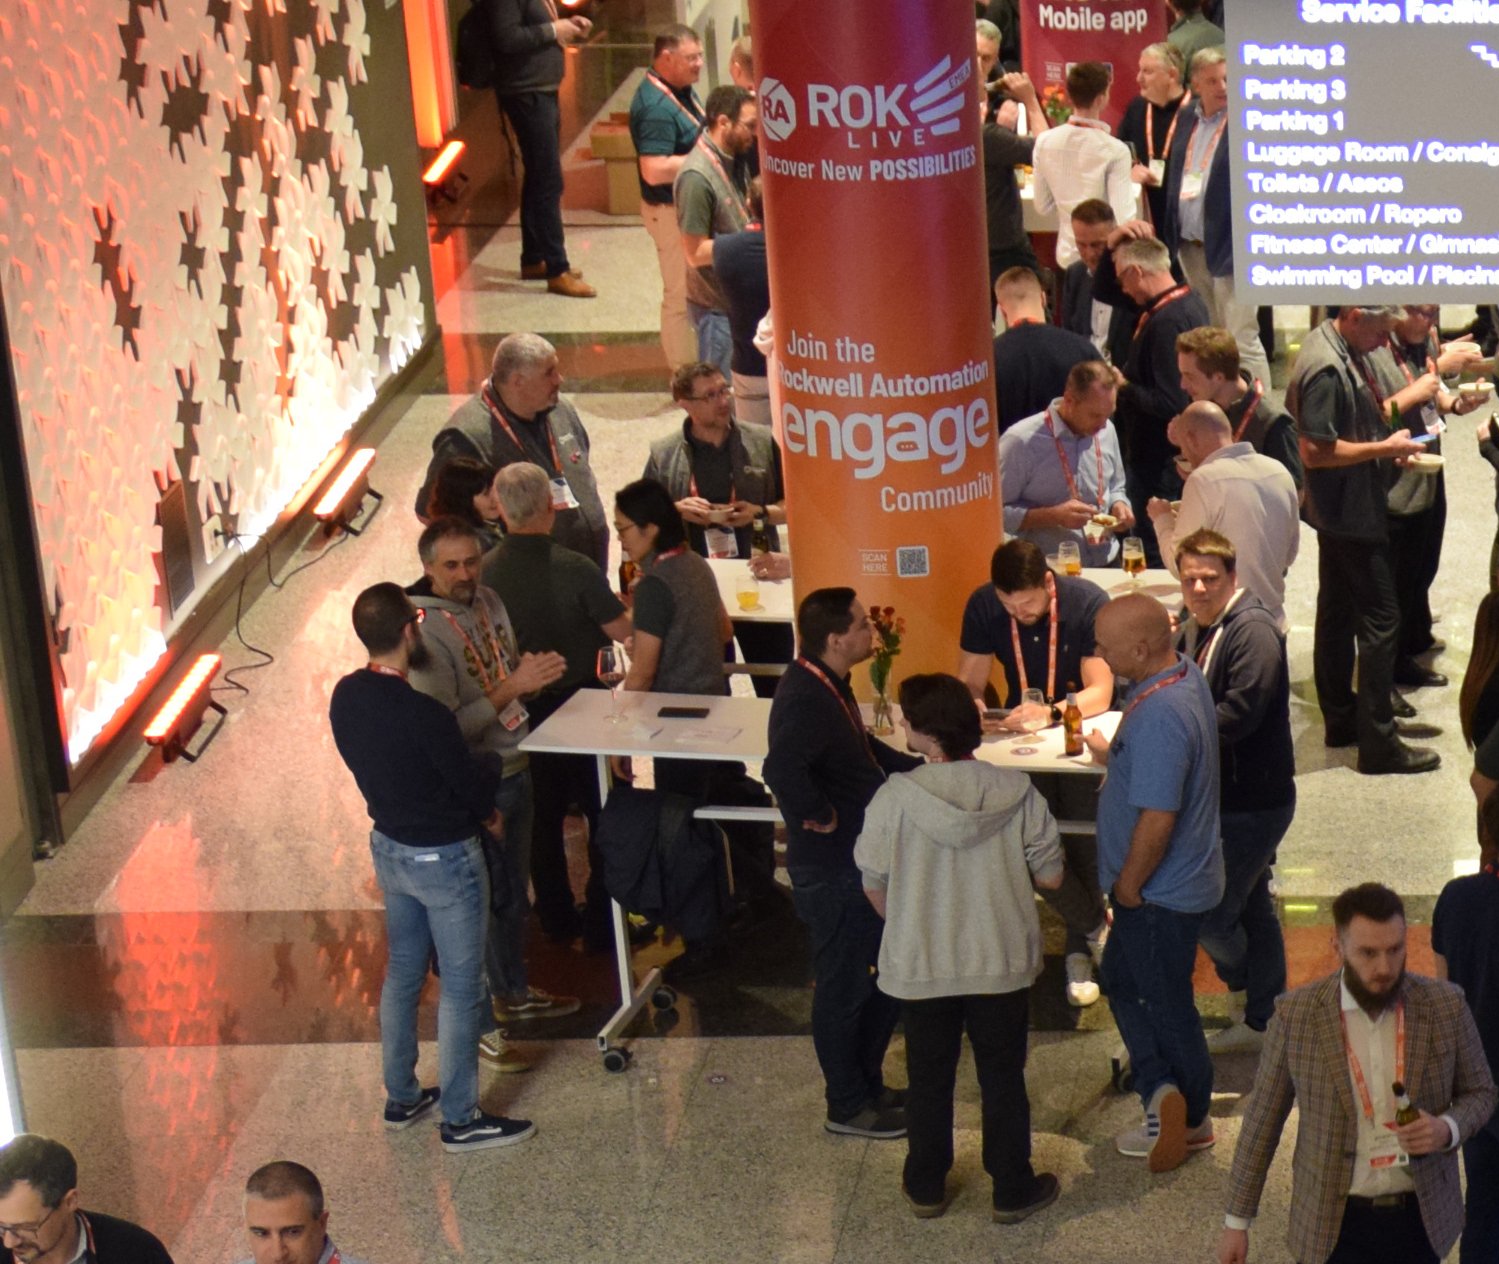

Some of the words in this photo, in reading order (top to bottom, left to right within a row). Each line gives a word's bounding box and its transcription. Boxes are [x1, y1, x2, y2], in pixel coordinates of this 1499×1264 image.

[1039, 4, 1106, 31] Mobile
[1110, 9, 1148, 34] app
[1301, 0, 1401, 24] Service
[1243, 44, 1327, 70] Parking
[1329, 44, 1346, 67] 2
[1244, 79, 1328, 104] Parking
[1331, 79, 1347, 101] 3
[763, 99, 791, 125] RA
[807, 83, 911, 128] ROK
[1246, 110, 1329, 135] Parking
[1332, 110, 1344, 131] 1
[848, 128, 925, 149] LIVE
[821, 159, 862, 182] New
[870, 145, 976, 182] POSSIBILITIES
[1247, 142, 1341, 165] Luggage
[1345, 142, 1410, 162] Room
[1411, 142, 1424, 162] /
[1248, 173, 1319, 193] Toilets
[1322, 172, 1334, 193] /
[1249, 204, 1367, 225] Cloakroom
[1370, 203, 1381, 224] /
[1384, 204, 1463, 227] Ropero
[1251, 234, 1328, 255] Fitness
[1330, 234, 1402, 255] Center
[1406, 234, 1417, 254] /
[1251, 265, 1362, 290] Swimming
[1366, 265, 1414, 285] Pool
[1417, 264, 1428, 285] /
[787, 330, 828, 362] Join
[836, 336, 875, 363] the
[870, 359, 989, 398] Automation
[782, 398, 990, 480] engage
[881, 472, 993, 512] Community
